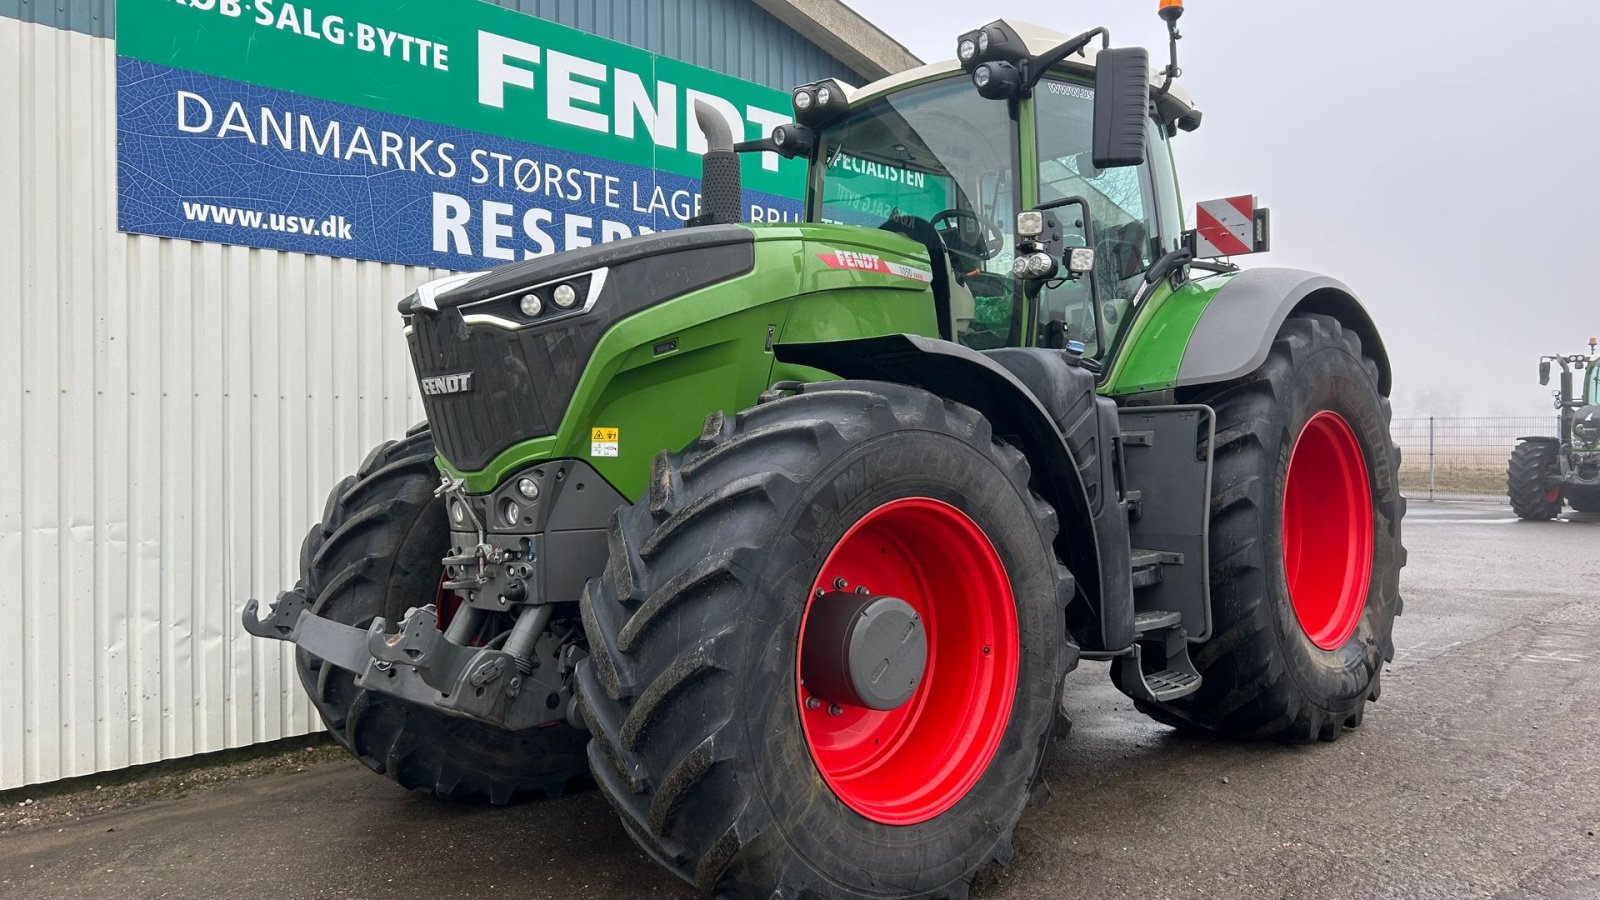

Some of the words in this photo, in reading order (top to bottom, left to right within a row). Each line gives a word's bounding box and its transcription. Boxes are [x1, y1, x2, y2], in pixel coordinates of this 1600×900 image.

[478, 29, 795, 173] FENDT
[176, 89, 457, 179] DANMARKS
[470, 147, 620, 209] STØRSTE
[827, 153, 925, 189] PECIALISTEN
[181, 201, 352, 241] www.usv.dk
[833, 249, 880, 271] FENDT
[420, 371, 474, 396] FENDT
